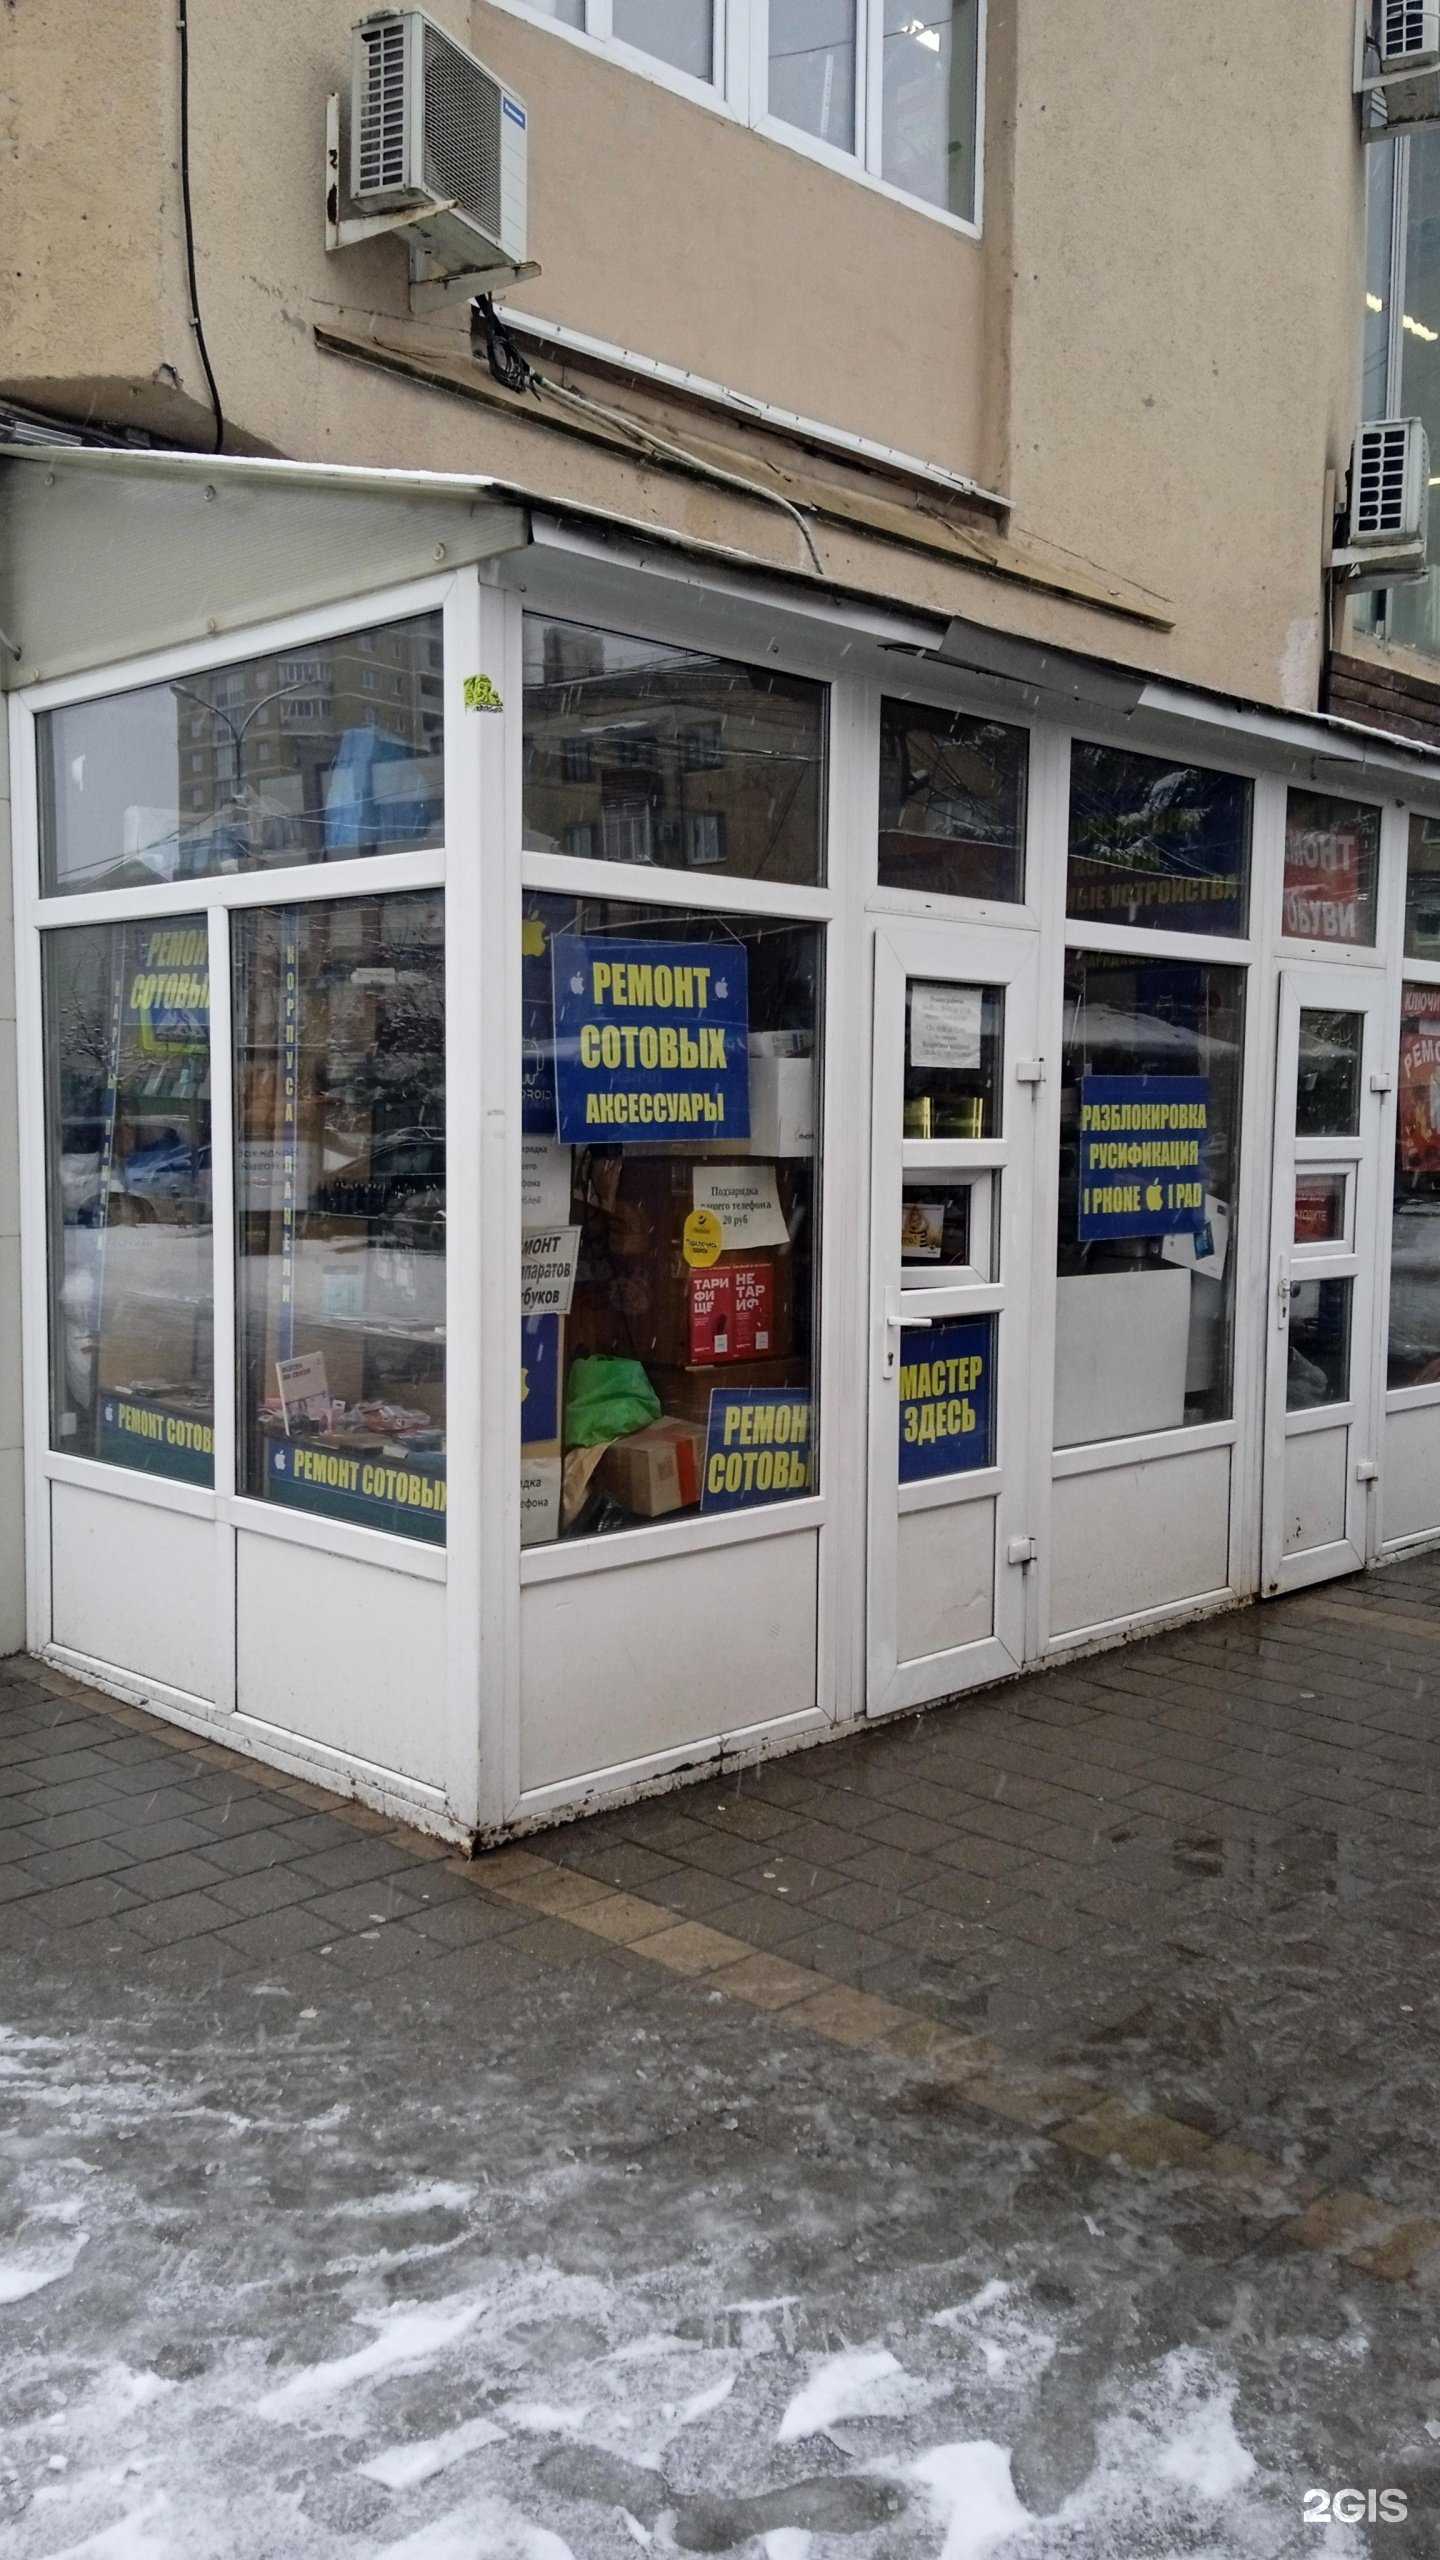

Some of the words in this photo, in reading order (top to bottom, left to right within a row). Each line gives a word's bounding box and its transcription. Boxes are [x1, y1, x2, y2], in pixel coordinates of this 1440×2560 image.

[593, 961, 711, 1008] РЕМОНТ
[580, 1024, 728, 1069] СОТОВЫХ
[586, 1092, 725, 1124] АКСЕССУАРЫ
[1081, 1103, 1208, 1131] РАЗБЛОКИРОВКА
[1089, 1141, 1199, 1170] РУСИФИКАЦИЯ
[1093, 1185, 1141, 1213] PHONE
[1176, 1182, 1203, 1208] PAD
[693, 1277, 730, 1290] ТАРИ
[736, 1272, 756, 1286] НЕ
[736, 1285, 766, 1299] ТАР
[693, 1290, 715, 1301] ФИ
[897, 1355, 983, 1402] МАСТЕР
[118, 1402, 165, 1441] РЕМОНТ
[166, 1417, 216, 1456] СОТОВ
[723, 1404, 809, 1446] РЕМОН
[904, 1398, 976, 1446] ЗДЕСЬ
[293, 1449, 361, 1492] РЕМОНТ
